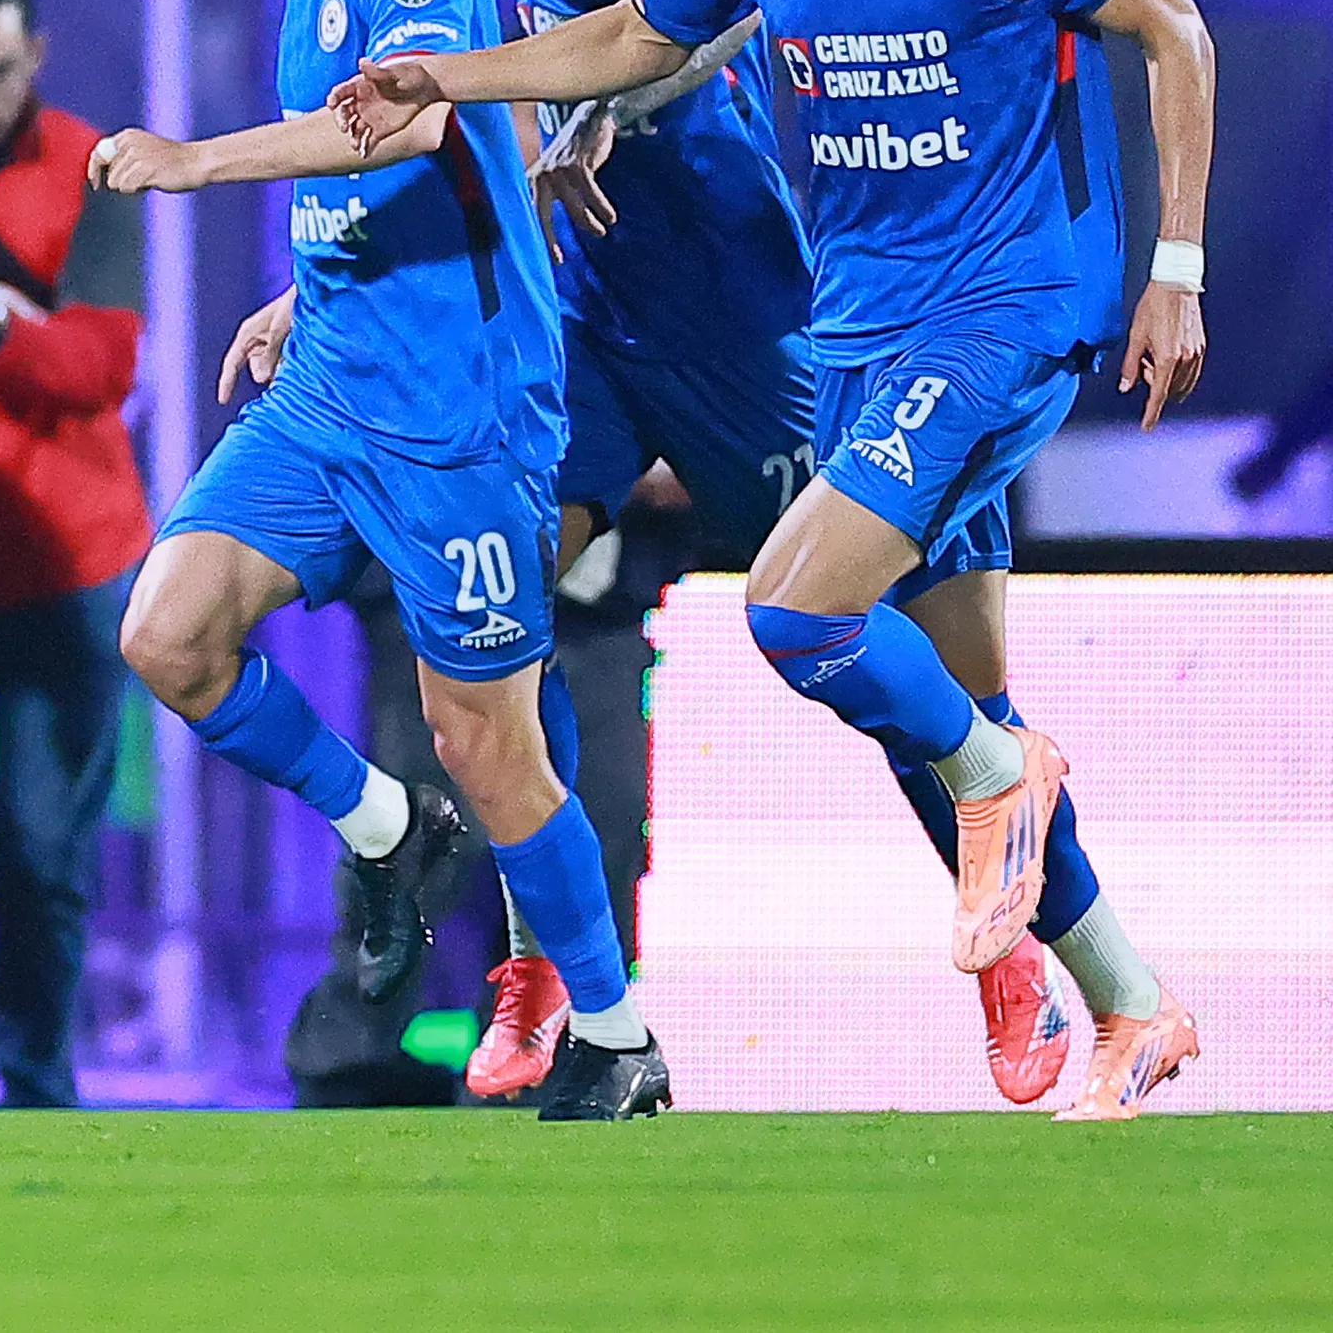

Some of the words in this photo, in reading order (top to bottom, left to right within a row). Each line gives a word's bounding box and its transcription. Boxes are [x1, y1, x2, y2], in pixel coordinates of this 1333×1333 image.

[815, 30, 948, 64] CEMENTO
[824, 70, 885, 98] CRUZ
[887, 62, 958, 97] AZUL
[893, 376, 949, 430] 5
[849, 441, 914, 487] PIRMA
[444, 531, 516, 613] 20
[459, 627, 527, 649] PIRMA
